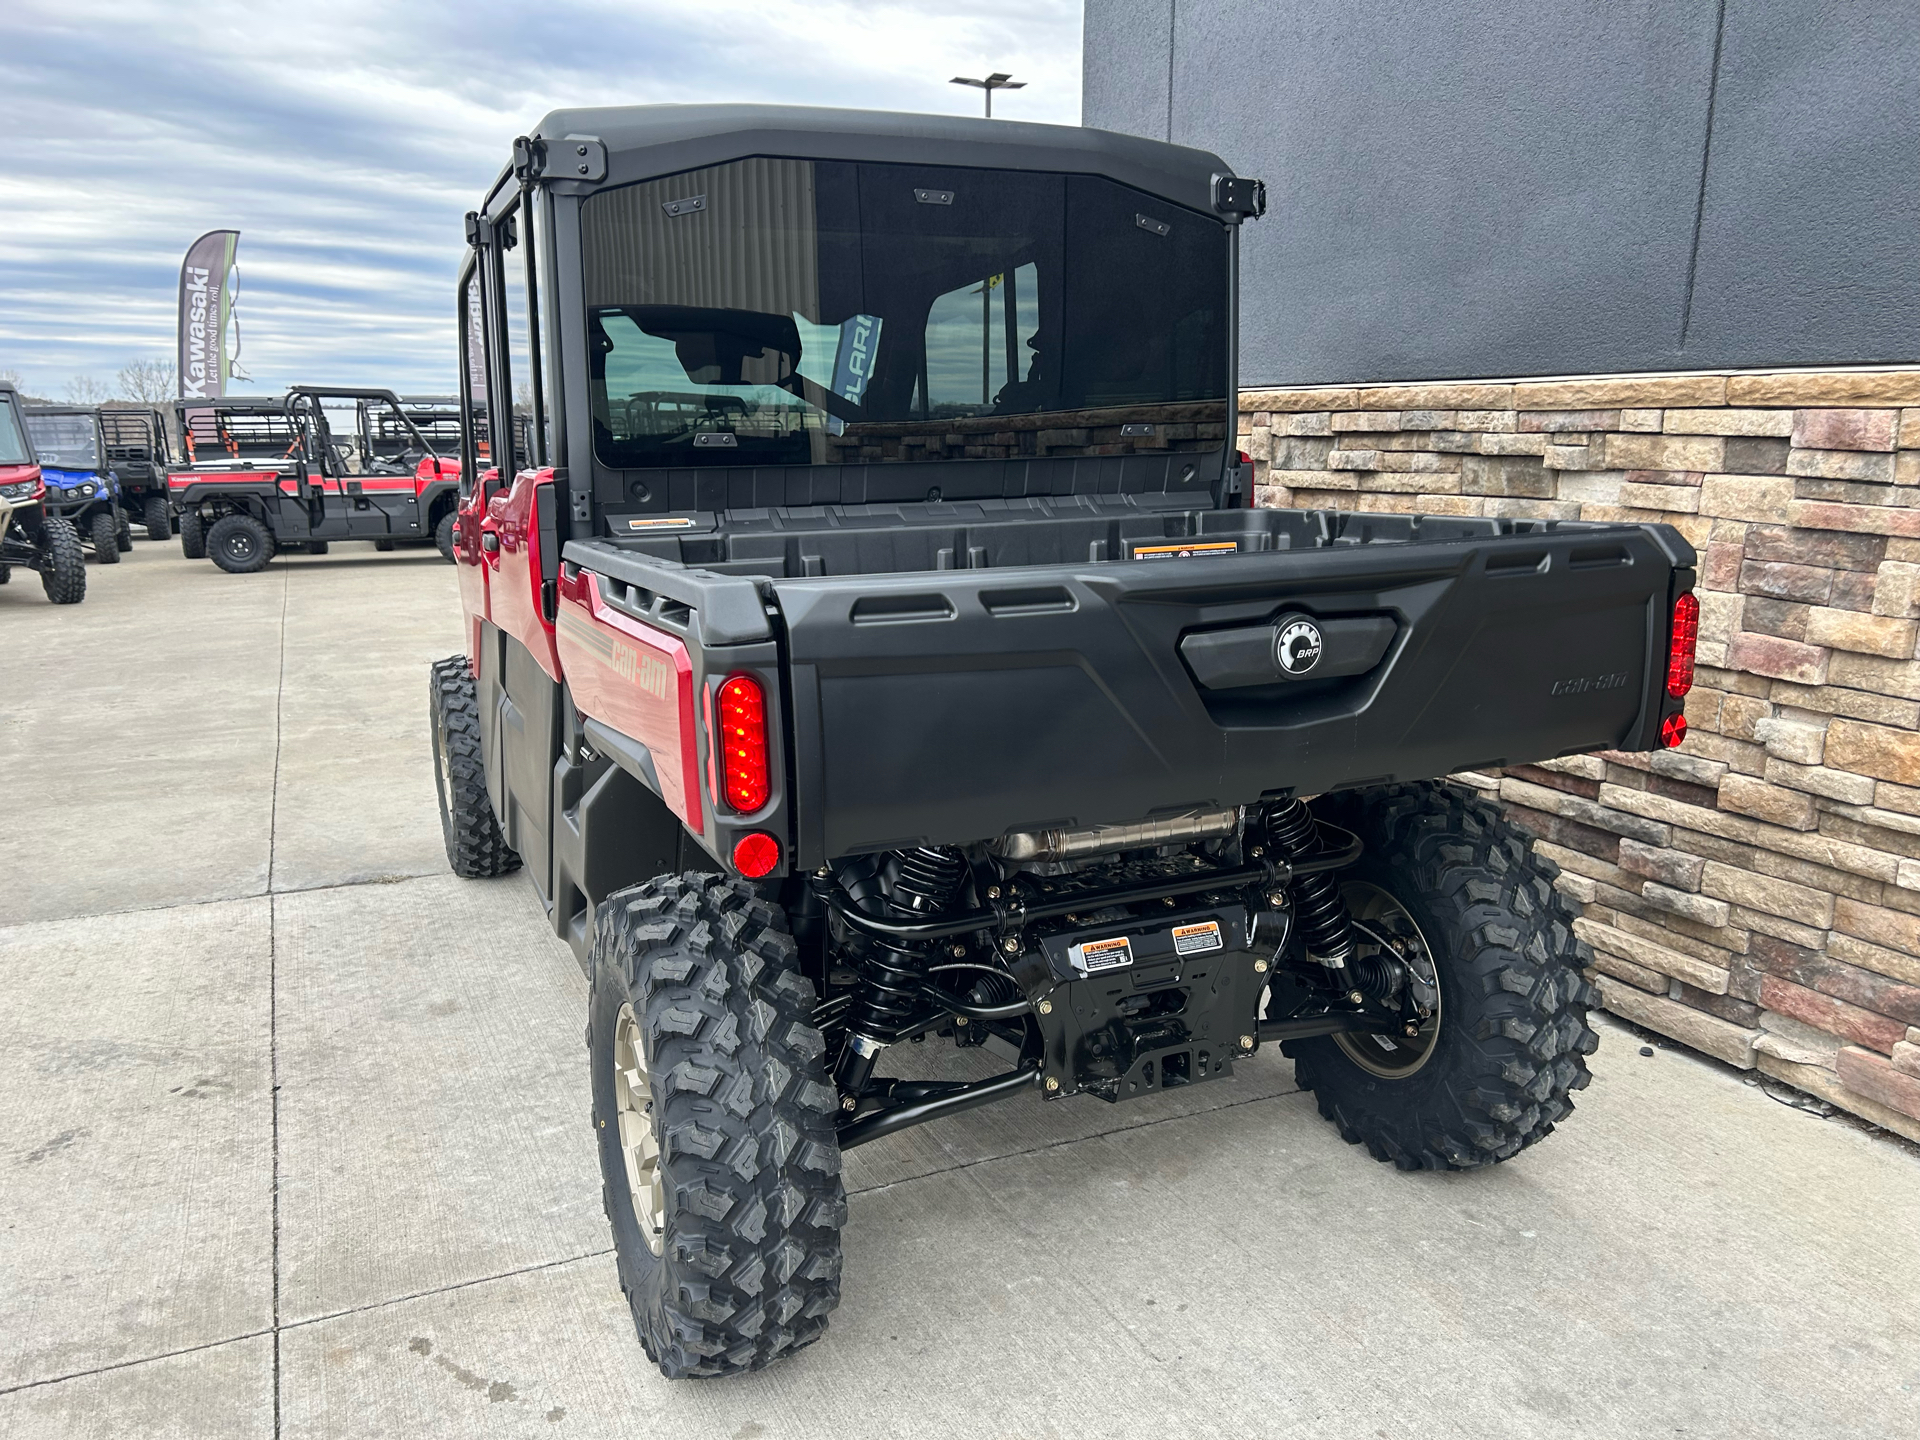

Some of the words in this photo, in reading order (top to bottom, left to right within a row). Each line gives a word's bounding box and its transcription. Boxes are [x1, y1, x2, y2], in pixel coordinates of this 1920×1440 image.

[207, 304, 218, 328] times
[183, 266, 209, 398] Kawasaki
[208, 328, 220, 352] good
[207, 352, 218, 367] the
[207, 368, 218, 384] Let
[1297, 647, 1319, 659] BRP
[1096, 941, 1121, 950] WARNING
